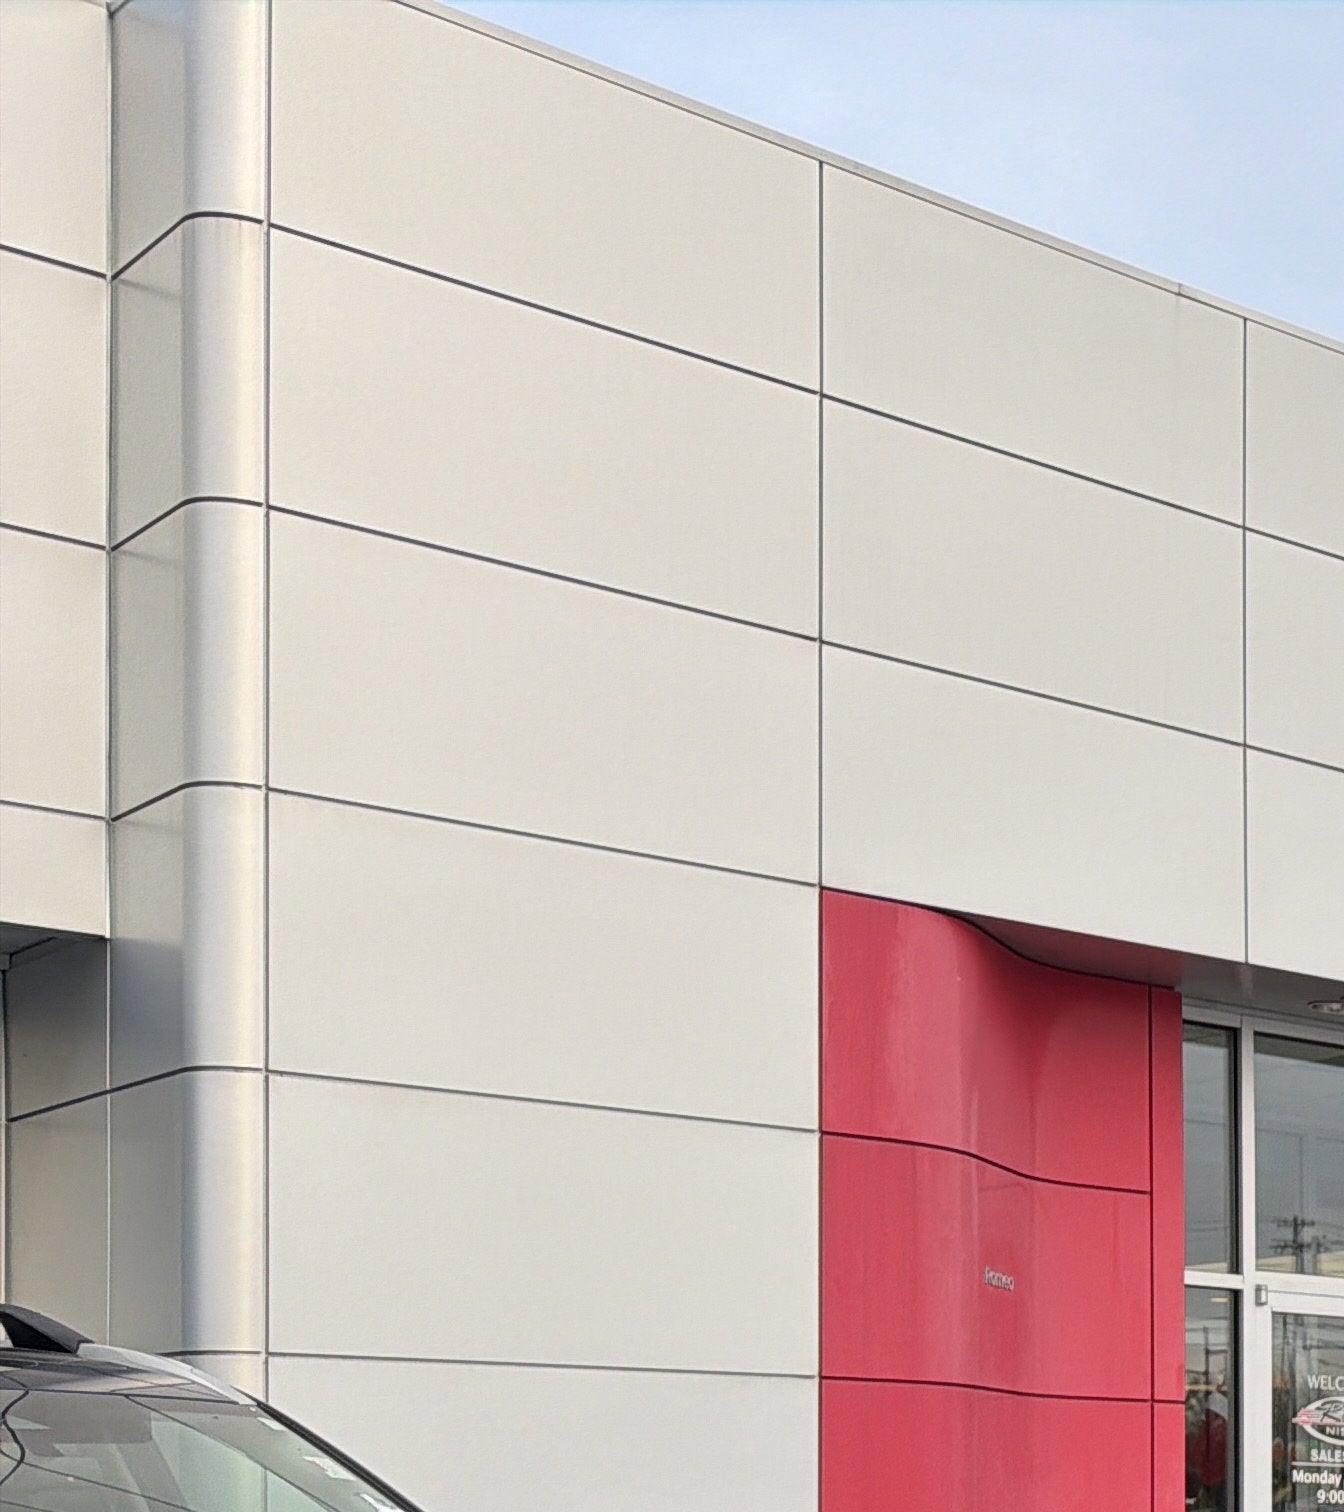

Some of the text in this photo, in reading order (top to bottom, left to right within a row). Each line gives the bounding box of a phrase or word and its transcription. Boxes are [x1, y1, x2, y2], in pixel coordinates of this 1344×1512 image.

[985, 1265, 1014, 1291] Romeo
[1292, 1470, 1342, 1486] Monday
[1317, 1490, 1344, 1504] 9:00
